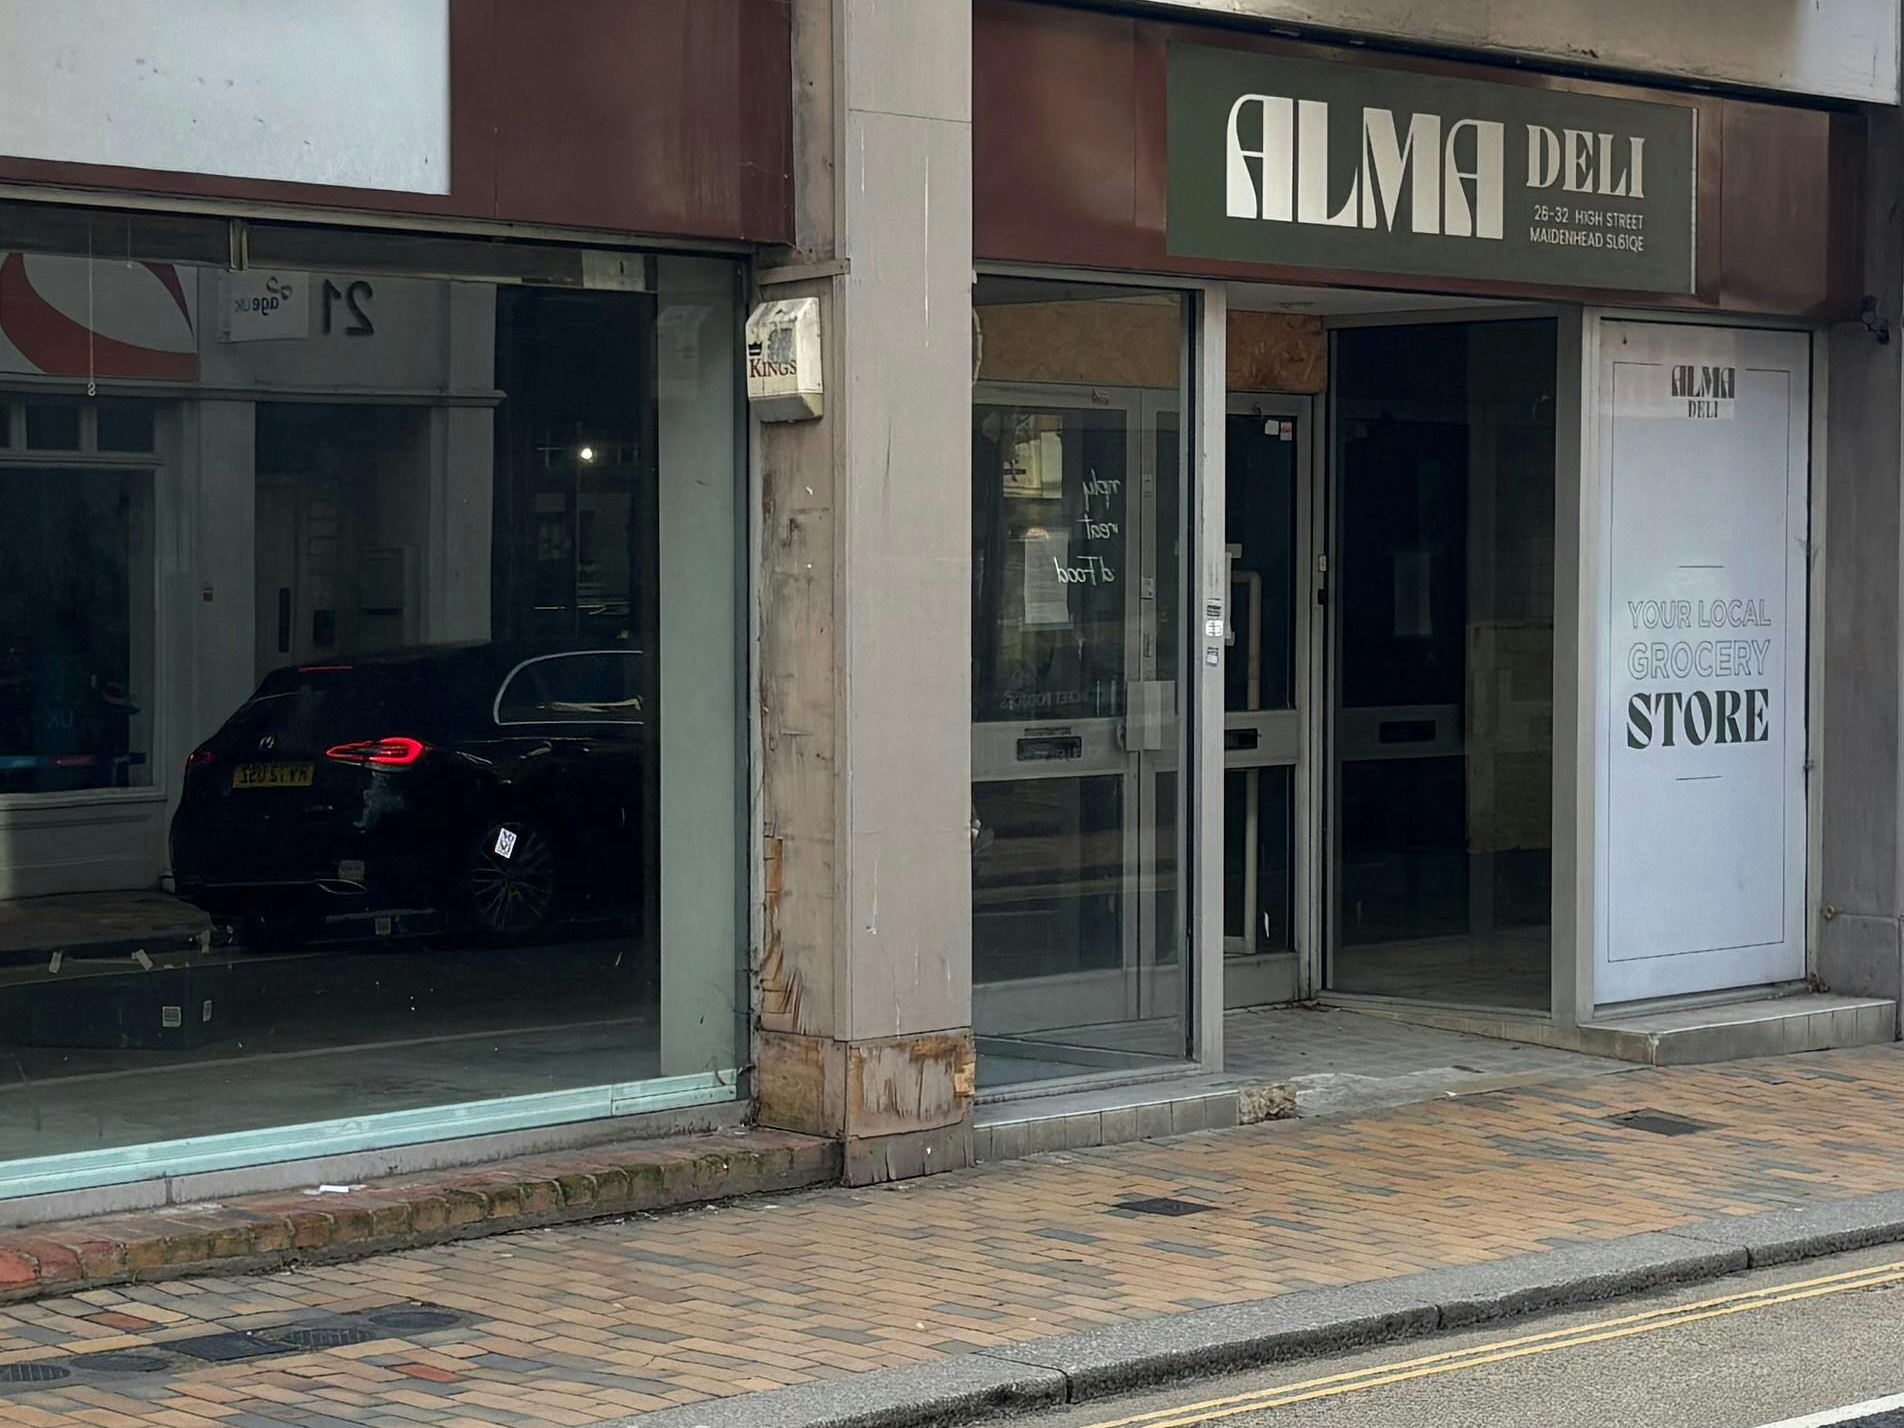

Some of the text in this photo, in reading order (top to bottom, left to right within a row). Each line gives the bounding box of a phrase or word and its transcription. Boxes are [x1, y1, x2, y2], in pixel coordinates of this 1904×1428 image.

[1226, 93, 1645, 240] ALMA DELI
[1575, 209, 1603, 227] HIGH
[1606, 212, 1644, 229] STREET
[1530, 227, 1644, 252] MAIDENHEAD SL61QE
[1672, 365, 1735, 399] ALMA
[1688, 400, 1719, 419] DELI
[1627, 599, 1772, 629] YOUR LOCAL
[1627, 639, 1771, 680] GROCERY
[1626, 688, 1769, 750] STORE
